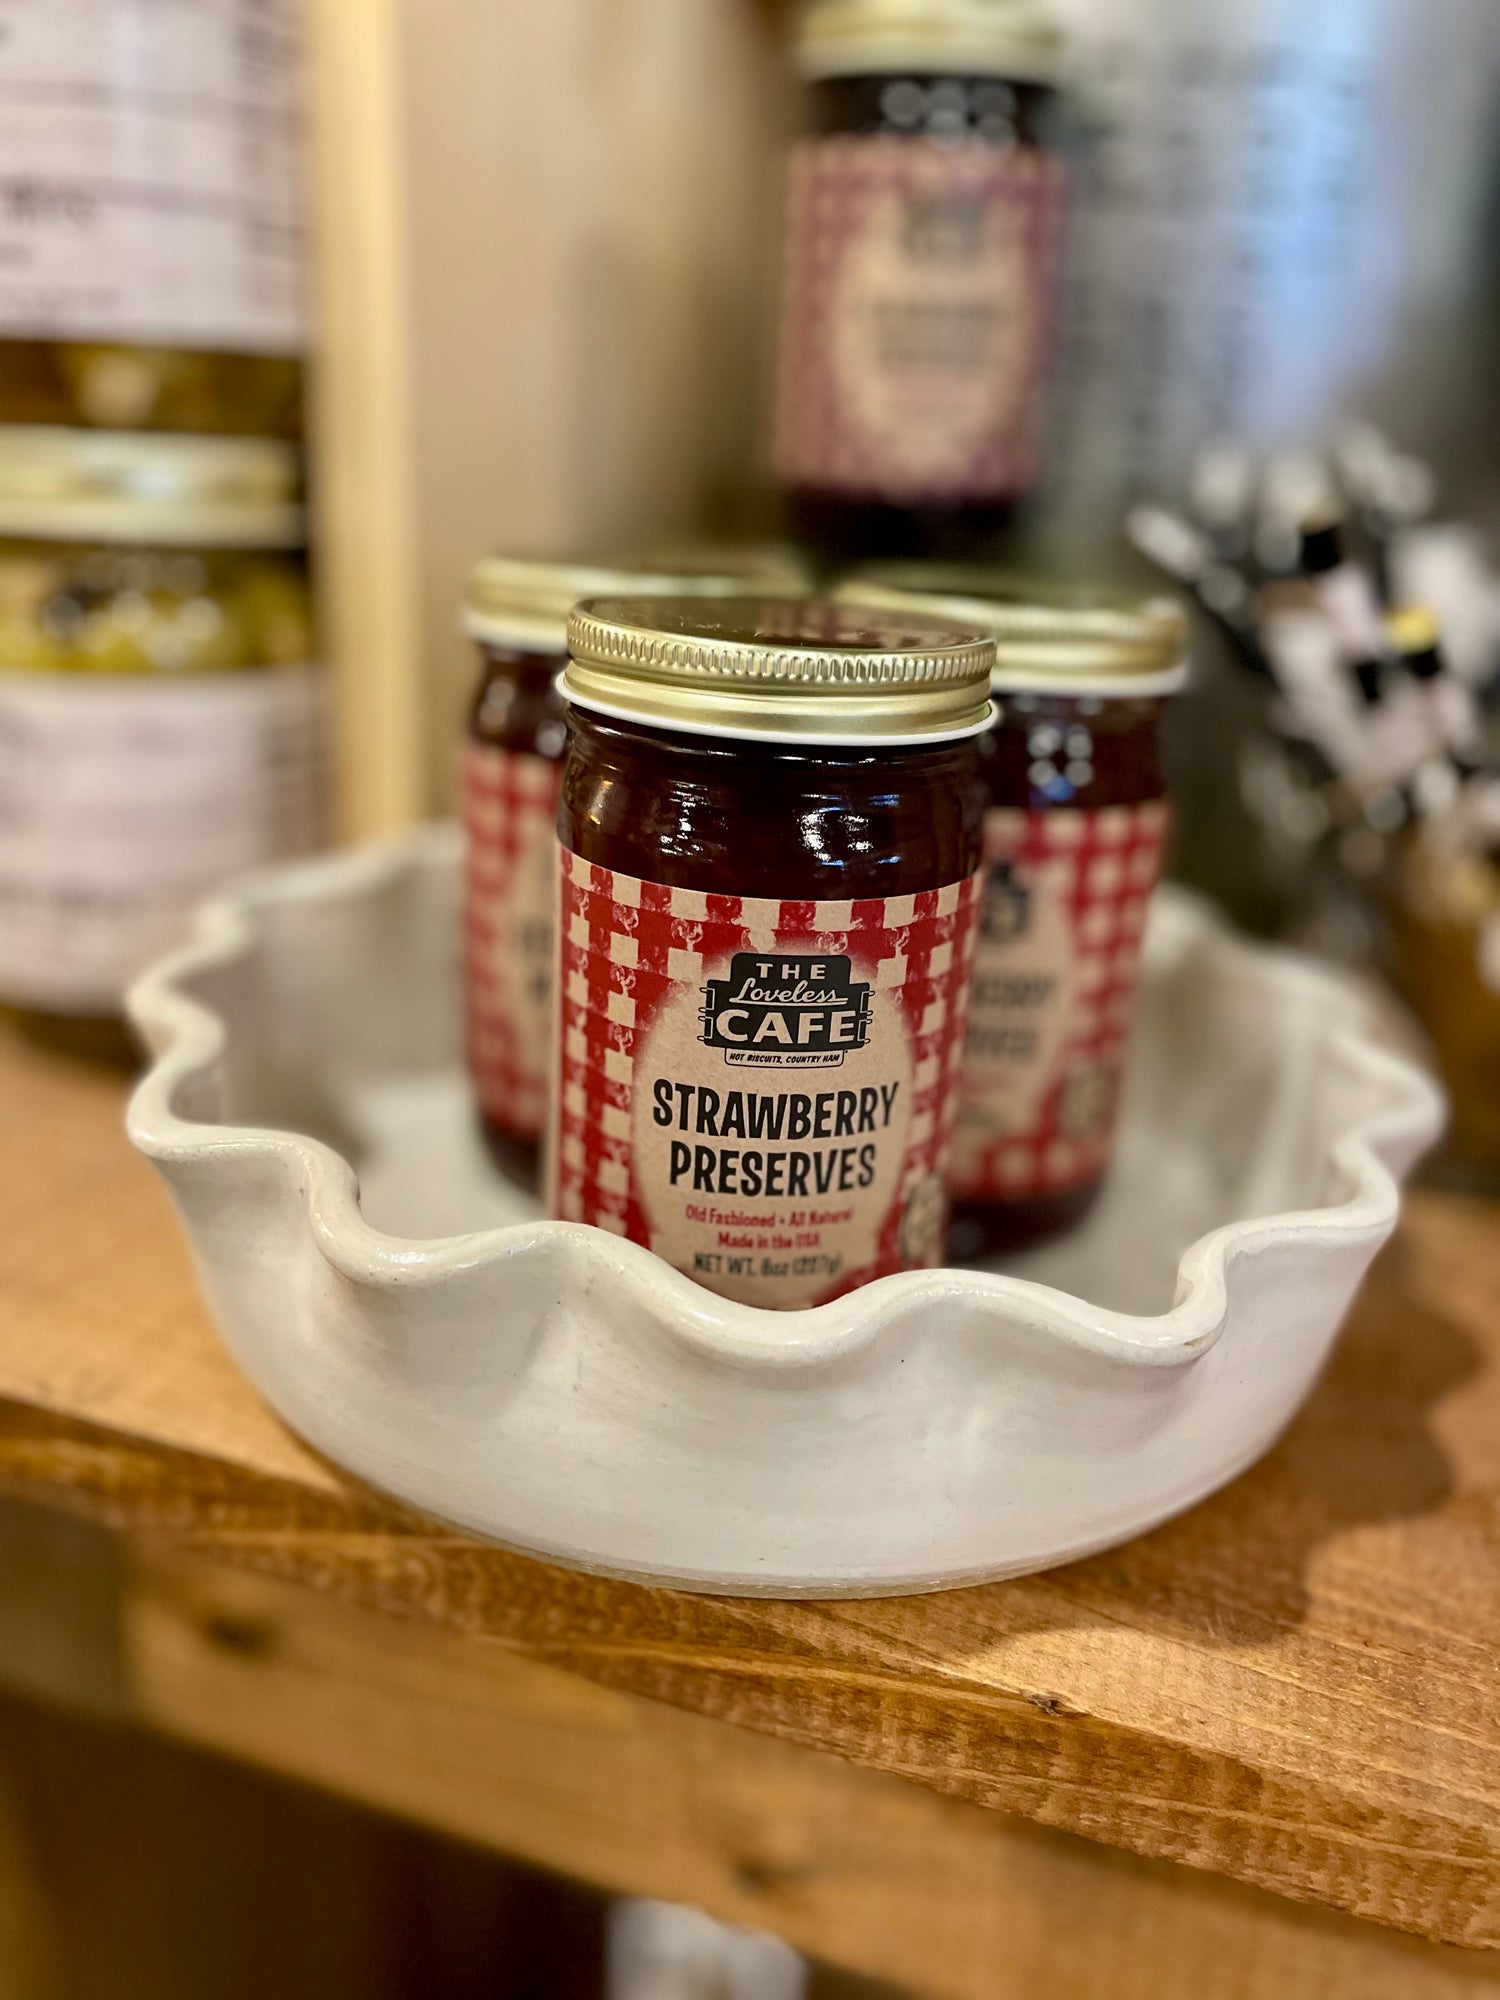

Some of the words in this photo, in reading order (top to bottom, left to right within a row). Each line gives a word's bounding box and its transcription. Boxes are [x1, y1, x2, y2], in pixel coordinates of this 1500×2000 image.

[756, 963, 826, 980] THE
[729, 977, 848, 1006] Loveless
[715, 1010, 857, 1044] CAFE
[729, 1053, 745, 1061] HOT
[747, 1054, 782, 1064] BISCUITS,
[786, 1055, 821, 1063] COUNTRY
[823, 1054, 840, 1062] HAM
[653, 1078, 900, 1140] STRAWBERRY
[669, 1140, 876, 1196] PRESERVES
[685, 1204, 706, 1223] Old
[709, 1208, 775, 1227] Fashioned
[789, 1211, 805, 1226] All
[717, 1232, 753, 1248] Made
[757, 1234, 768, 1248] in
[771, 1234, 792, 1248] the
[795, 1232, 821, 1248] USA
[693, 1253, 722, 1273] NET
